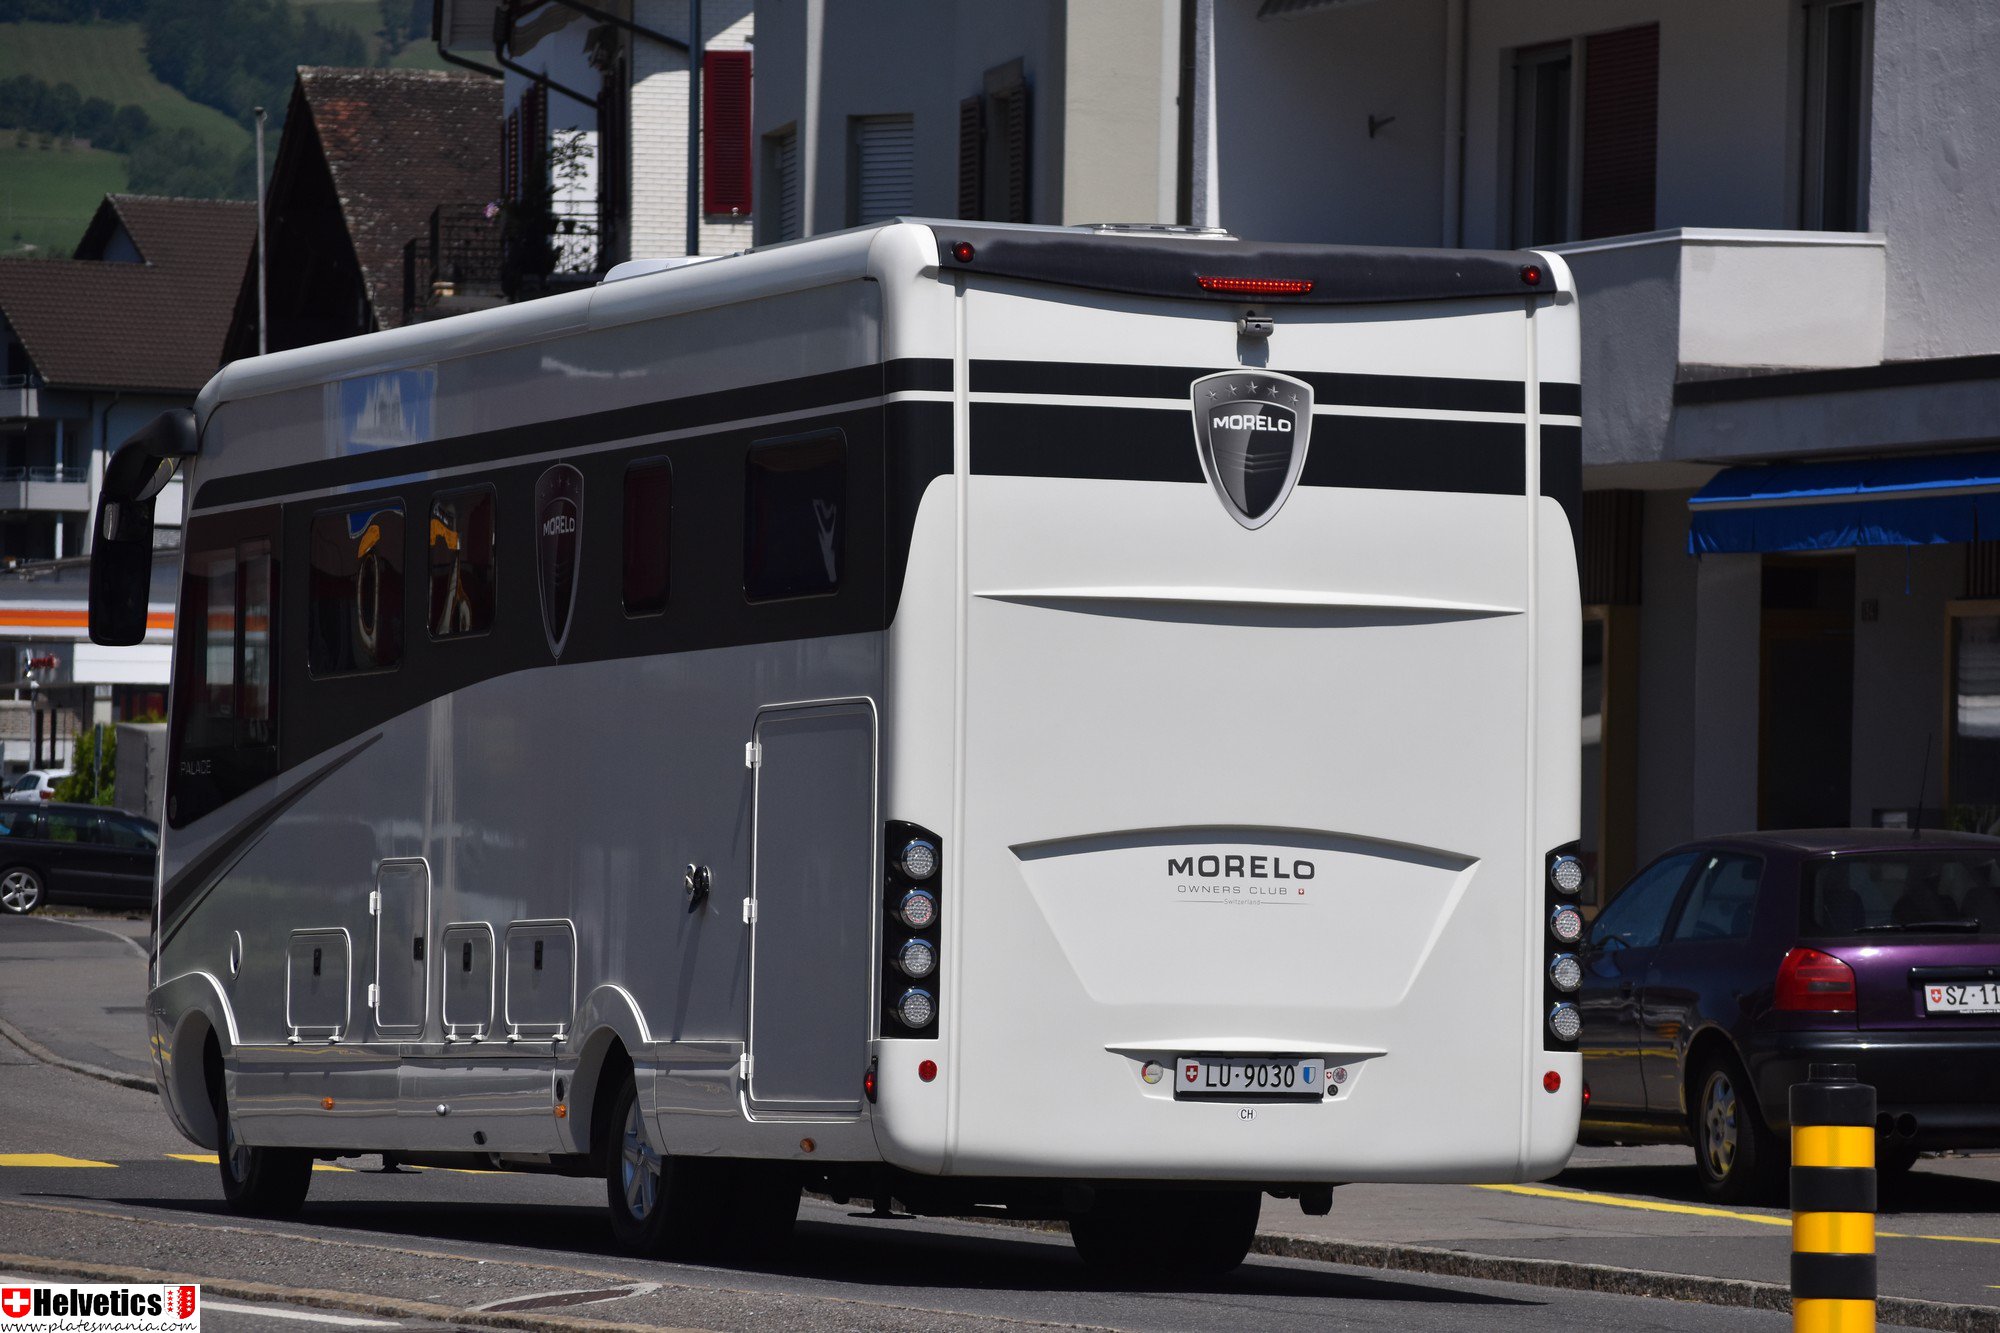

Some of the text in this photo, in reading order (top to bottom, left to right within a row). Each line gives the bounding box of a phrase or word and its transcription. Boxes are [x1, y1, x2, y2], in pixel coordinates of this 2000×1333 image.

[1213, 414, 1292, 433] MORELO
[542, 515, 576, 537] MORELO
[180, 759, 212, 776] PALACE
[1167, 854, 1316, 880] MORELO
[1177, 884, 1288, 895] OWNERS CLUB
[1223, 898, 1262, 906] Switzerland
[1240, 1108, 1254, 1120] CH
